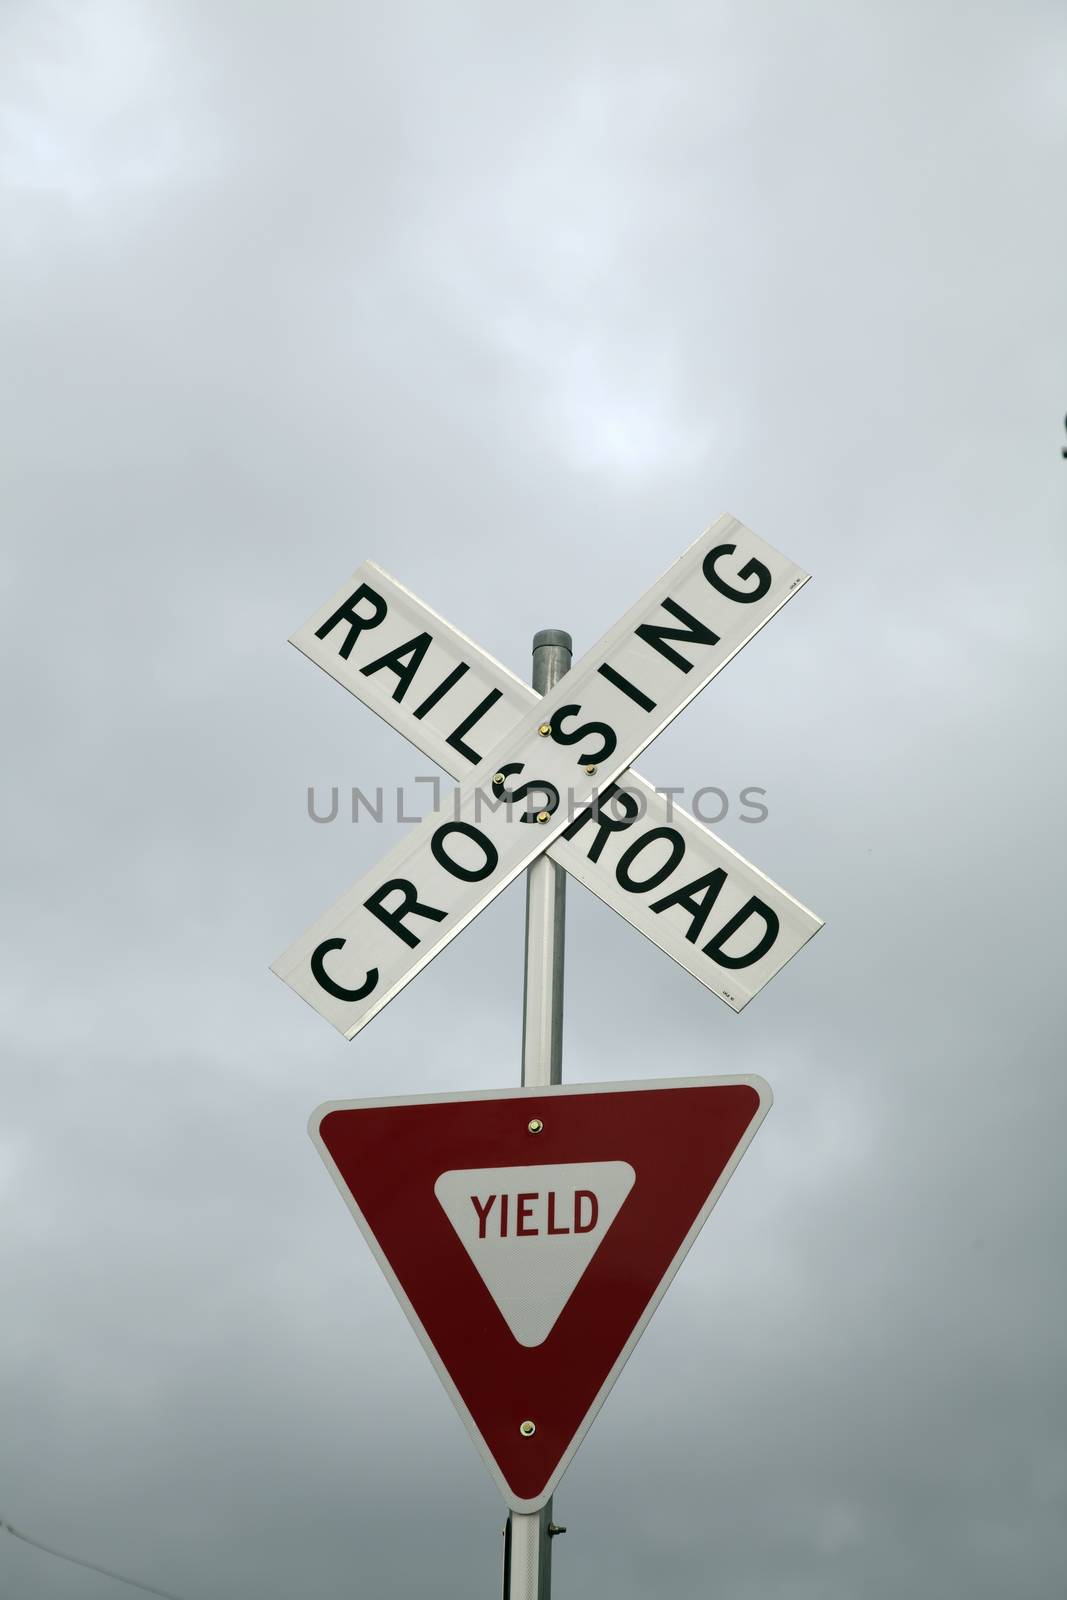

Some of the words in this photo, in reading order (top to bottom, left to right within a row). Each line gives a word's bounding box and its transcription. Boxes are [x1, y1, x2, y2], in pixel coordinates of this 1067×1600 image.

[310, 543, 772, 1003] CROSSING
[314, 582, 503, 766] RAIL
[560, 783, 780, 970] ROAD
[470, 1189, 599, 1239] YIELD
